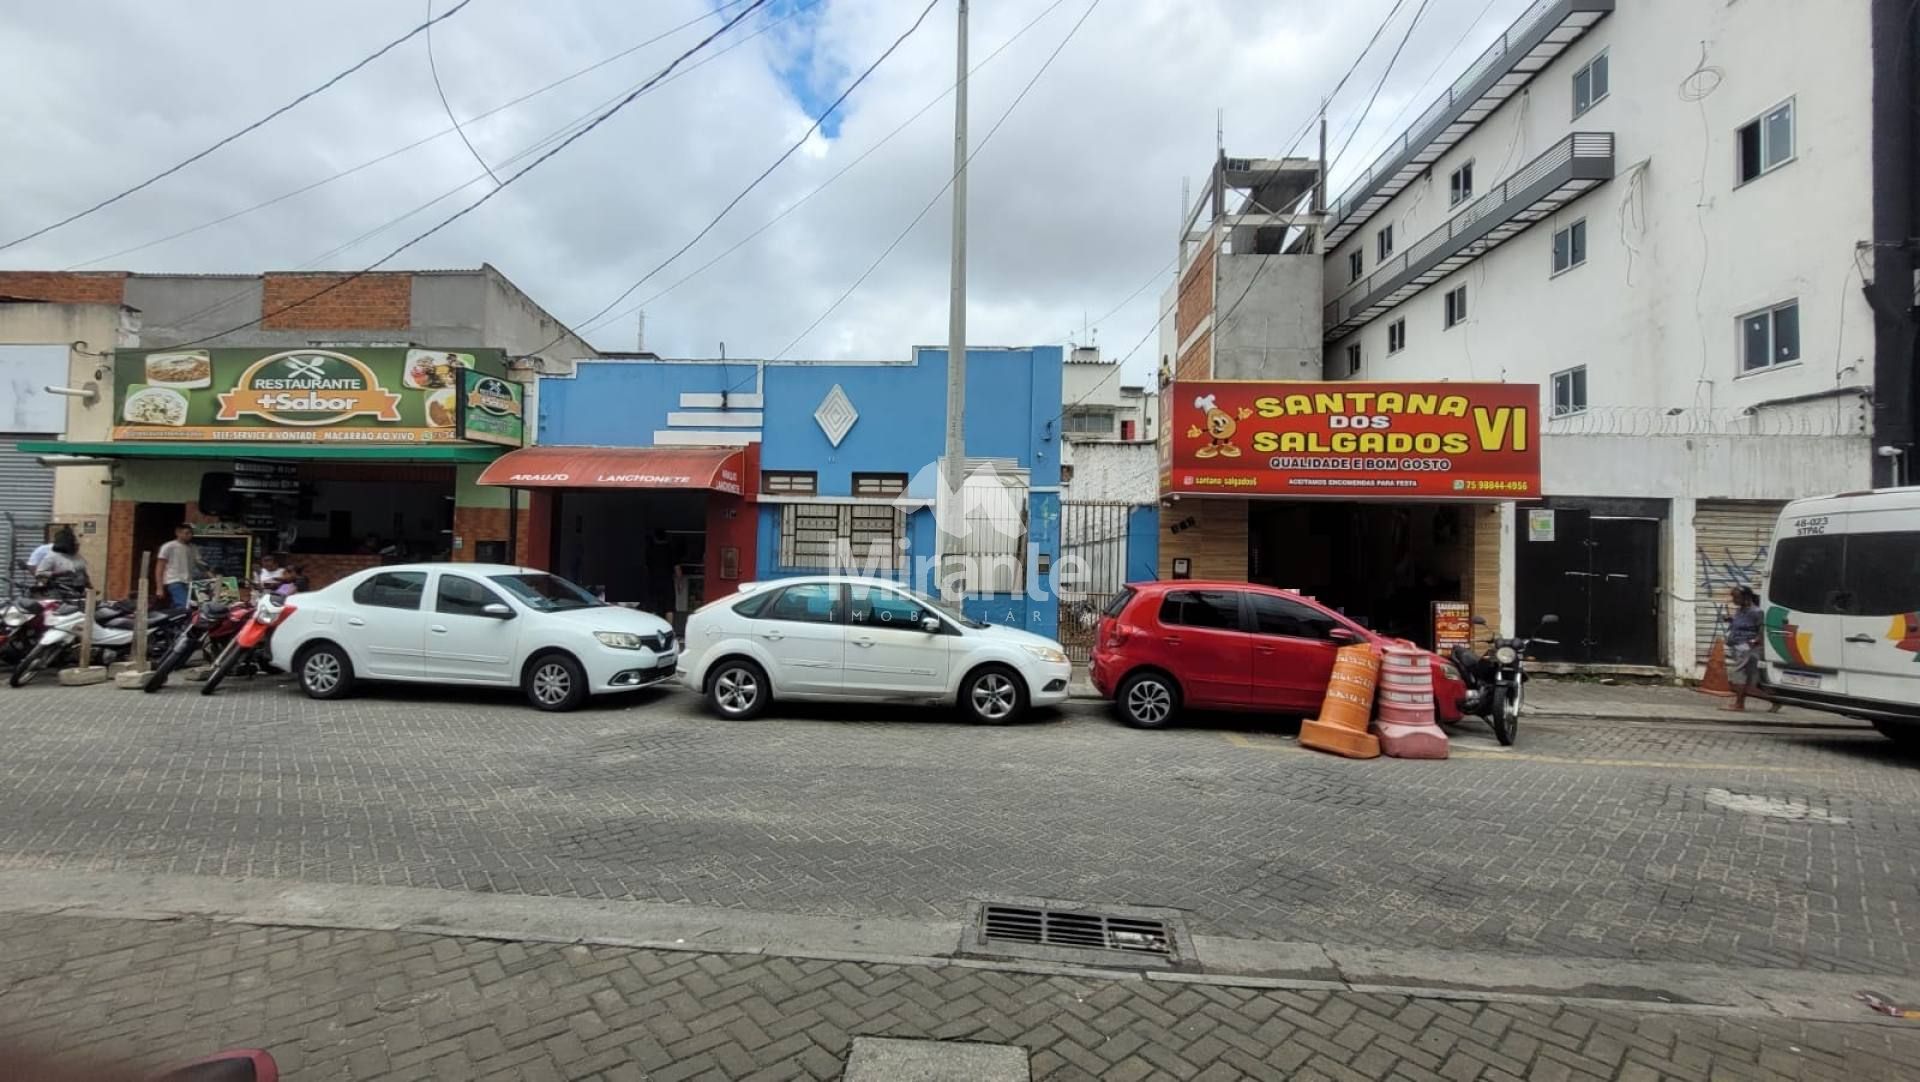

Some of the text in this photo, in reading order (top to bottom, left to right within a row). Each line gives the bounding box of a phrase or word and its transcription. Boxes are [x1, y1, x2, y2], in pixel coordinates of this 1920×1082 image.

[254, 378, 361, 390] RESTAURANTE
[257, 391, 358, 410] +Sabor
[1254, 391, 1470, 418] SANTANA
[1329, 415, 1390, 429] DOS
[1473, 406, 1527, 451] VI
[391, 431, 415, 441] VIVO
[1253, 431, 1469, 454] SALGADOS
[1270, 456, 1451, 471] QUALIDADE E BOM GOSTO
[510, 473, 691, 483] ARAUJO LANCHONETE
[1466, 480, 1477, 489] 75
